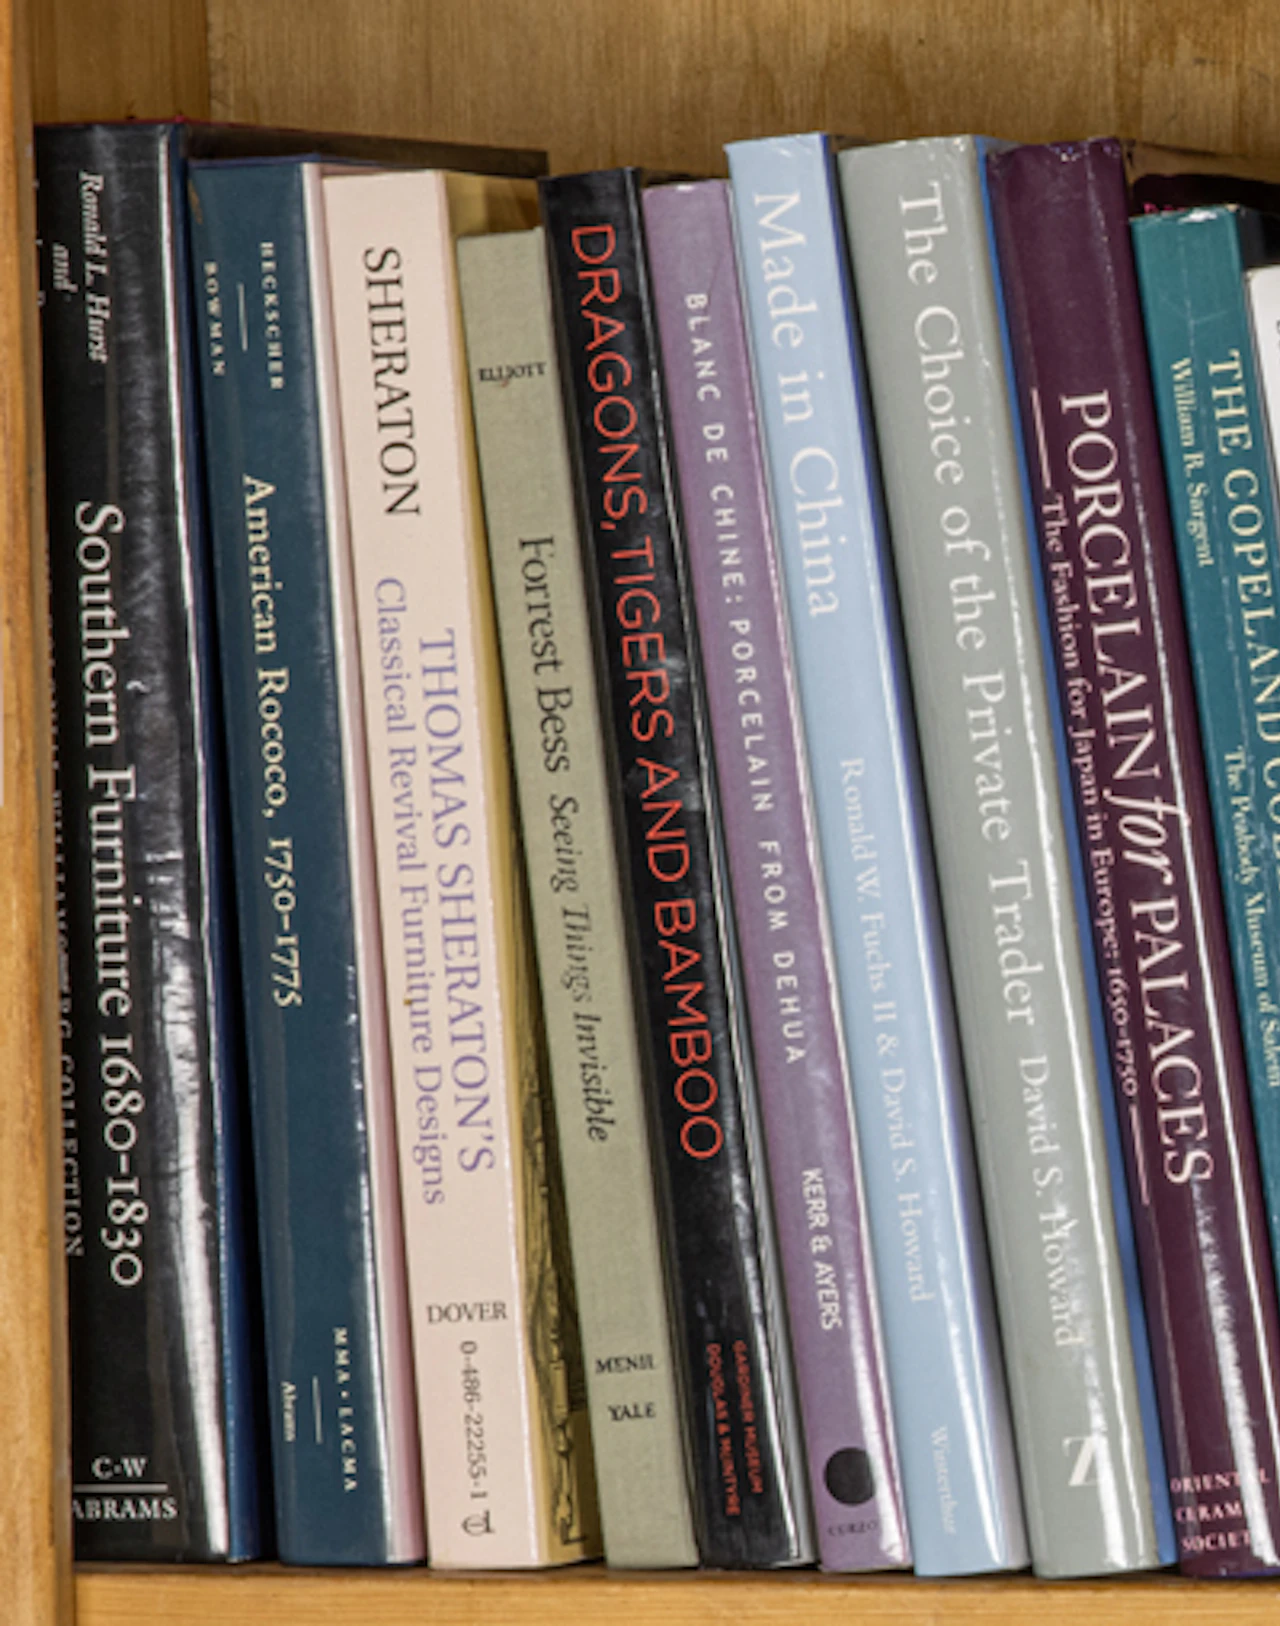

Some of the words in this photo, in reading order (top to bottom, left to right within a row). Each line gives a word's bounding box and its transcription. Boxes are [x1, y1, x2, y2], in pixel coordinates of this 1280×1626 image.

[898, 180, 948, 286] The
[204, 261, 226, 376] BOWMAN
[261, 242, 284, 390] HECKSCHER
[479, 362, 546, 384] ELLIOTT
[363, 246, 421, 517] SHERATON
[571, 224, 648, 532] DRAGONS,
[754, 190, 818, 348] Made
[790, 447, 848, 618] China
[914, 305, 972, 485] Choice
[1208, 348, 1252, 455] THE
[1170, 358, 1196, 447] William
[1186, 481, 1215, 567] Sargent
[243, 474, 284, 654] American
[940, 505, 992, 562] of
[1041, 492, 1069, 553] The
[74, 503, 130, 747] Southern
[519, 536, 563, 675] Forrest
[611, 536, 674, 742] TIGERS
[949, 573, 996, 651] the
[1049, 560, 1083, 670] Fashion
[1059, 389, 1160, 780] PORCELAIN
[373, 578, 416, 735] Classical
[685, 293, 721, 402] BLANC
[710, 484, 745, 604] CHINE:
[729, 618, 774, 812] PORCELAIN
[758, 841, 788, 931] FROM
[773, 951, 806, 1064] DEHUA
[1067, 677, 1093, 720] for
[257, 668, 290, 819] Rococo,
[419, 628, 470, 849] THOMAS
[537, 686, 573, 774] Bess
[962, 670, 1013, 845] Private
[1067, 727, 1099, 806] Japan
[389, 745, 427, 875] Revival
[549, 795, 584, 894] Seeing
[636, 757, 690, 881] AND
[840, 758, 876, 862] Ronald
[1103, 789, 1190, 885] for
[1230, 795, 1262, 886] Peabody
[87, 765, 144, 1017] Furniture
[988, 860, 1044, 1026] Trader
[1245, 892, 1270, 989] Museum
[401, 885, 439, 1054] Furniture
[561, 903, 596, 1003] Things
[861, 912, 891, 993] Fuchs
[573, 1012, 616, 1143] Invisible
[654, 899, 724, 1160] BAMBOO
[1130, 896, 1214, 1184] PALACES
[412, 1065, 447, 1206] Designs
[883, 1068, 915, 1149] David
[1019, 1055, 1061, 1154] David
[802, 1166, 830, 1230] KERR
[898, 1193, 935, 1302] Howard
[427, 1302, 507, 1324] DOVER
[813, 1259, 843, 1331] AYERS
[1039, 1203, 1086, 1346] Howard
[460, 1340, 488, 1500] 0-486-22255-1
[595, 1354, 656, 1374] MENIL
[608, 1402, 656, 1422] YALE
[72, 1498, 177, 1520] ABRAMS
